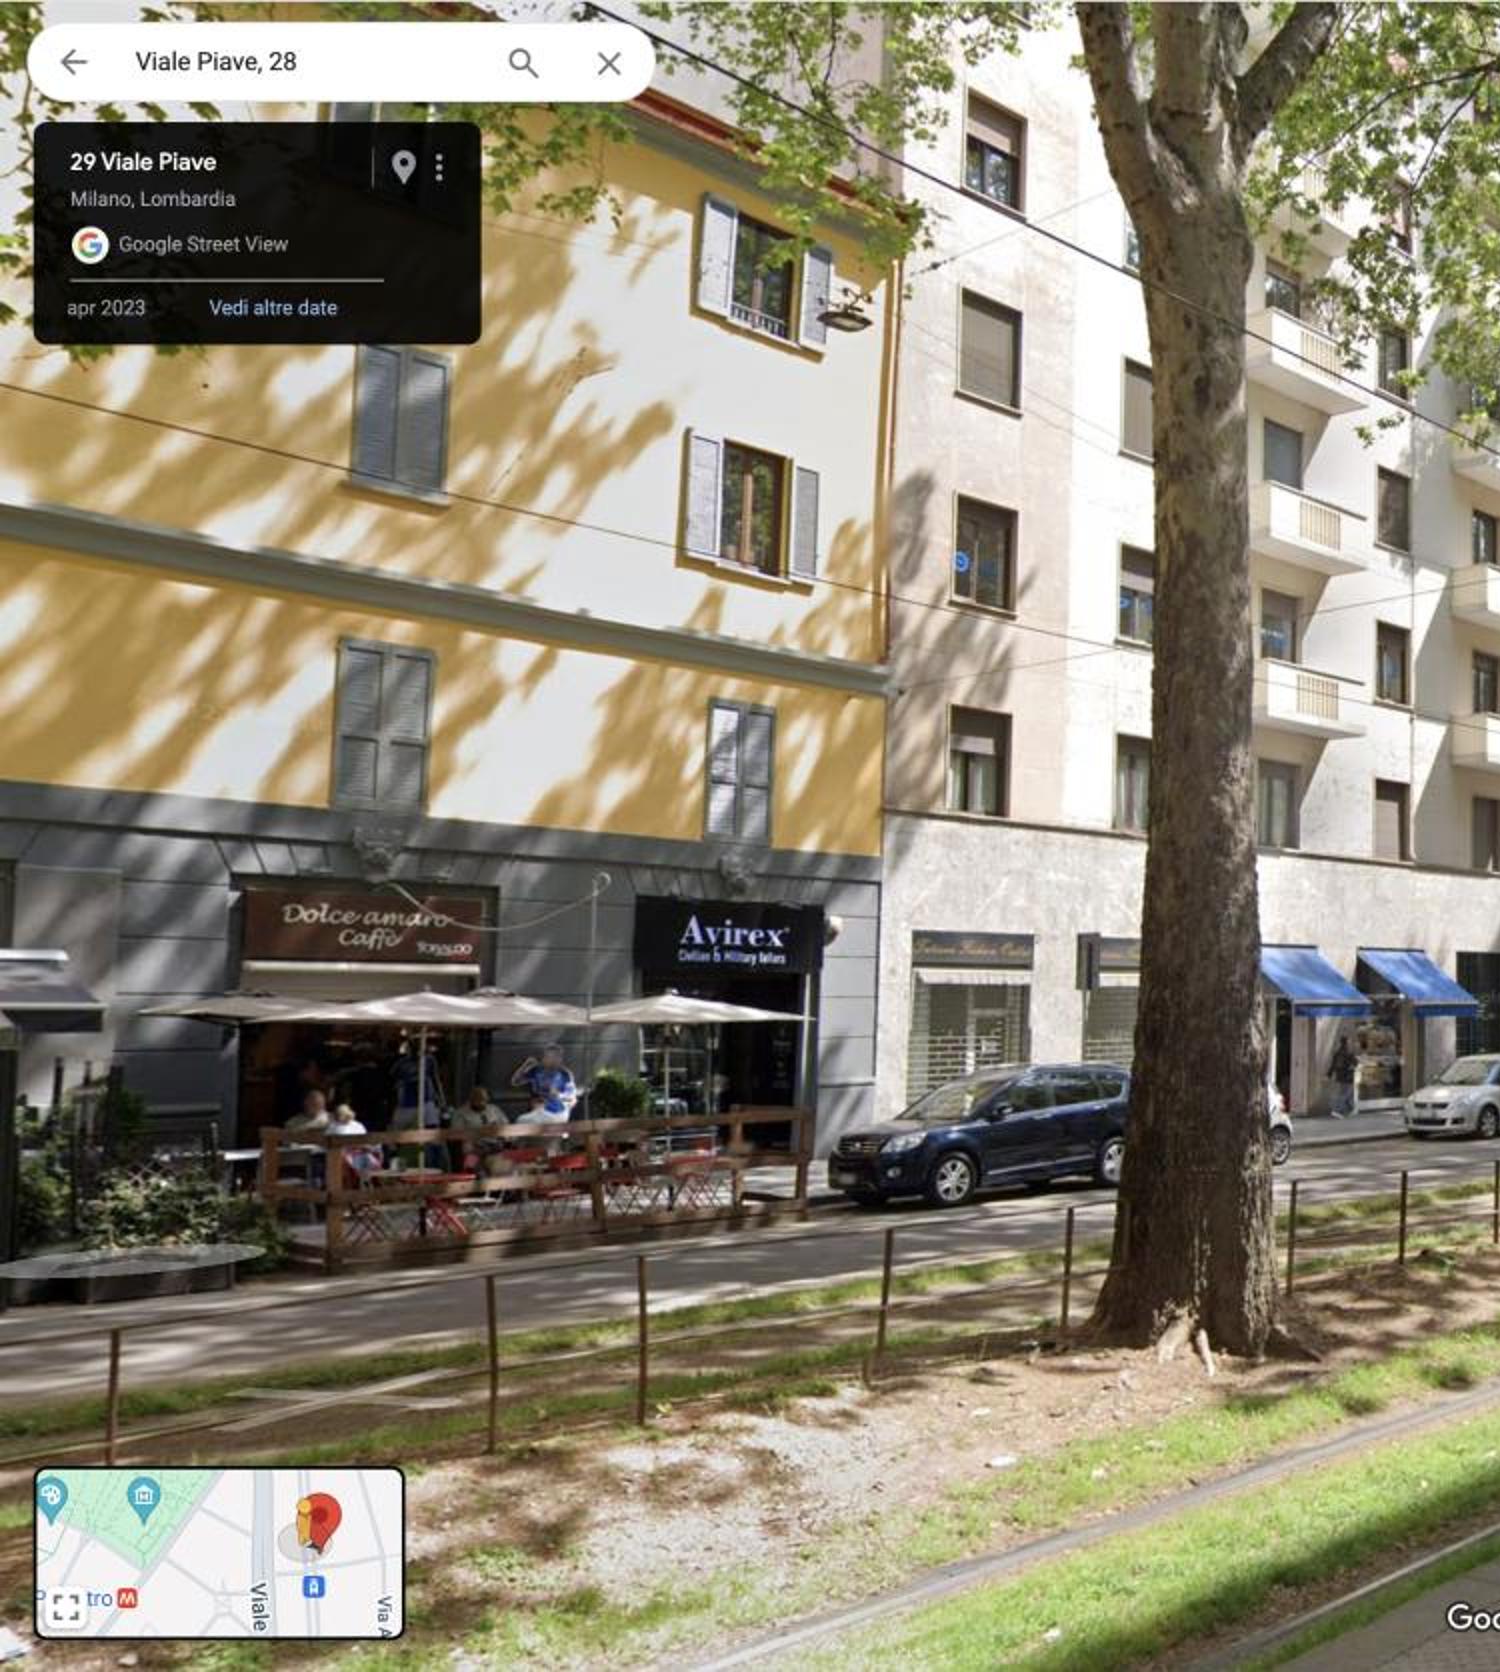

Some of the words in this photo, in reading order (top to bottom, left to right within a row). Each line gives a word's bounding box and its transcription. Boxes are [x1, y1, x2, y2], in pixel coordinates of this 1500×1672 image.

[282, 902, 358, 924] Dolce
[362, 909, 453, 928] amaro
[680, 914, 784, 948] Avirex
